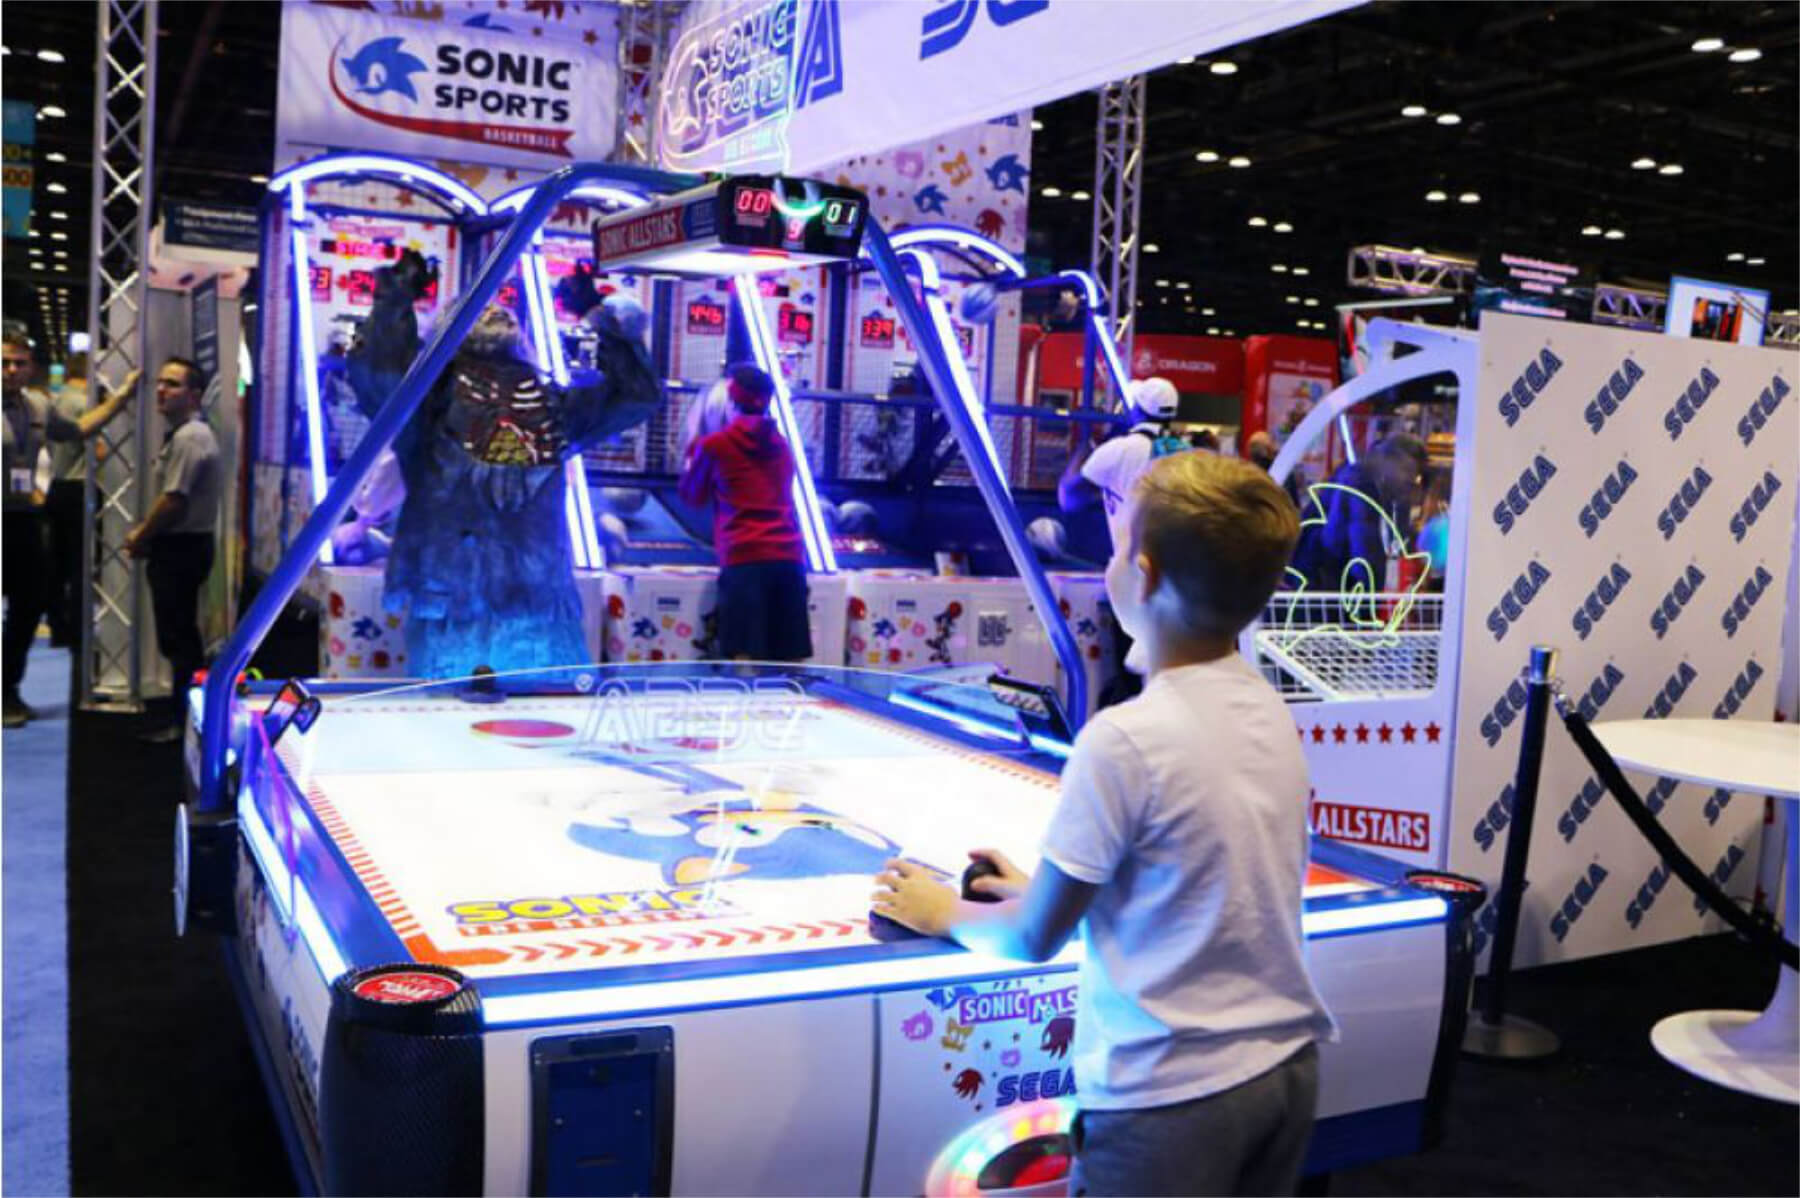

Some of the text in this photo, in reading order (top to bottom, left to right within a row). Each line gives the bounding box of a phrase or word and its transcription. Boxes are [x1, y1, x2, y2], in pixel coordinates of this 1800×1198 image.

[436, 43, 572, 91] SONIC
[434, 83, 570, 123] SPORTS
[483, 126, 558, 149] BASKETBALL
[629, 209, 678, 250] ALLSTARS
[737, 190, 768, 213] 00
[826, 203, 857, 224] 01
[1498, 347, 1564, 428] SEGA
[1583, 358, 1645, 435] SEGA
[1664, 367, 1721, 441] SEGA
[1737, 375, 1791, 447] SEGA
[1492, 454, 1558, 536] SEGA
[1578, 460, 1639, 539] SEGA
[1657, 466, 1713, 541] SEGA
[1729, 471, 1782, 544] SEGA
[1486, 560, 1551, 641] SEGA
[1572, 562, 1632, 640] SEGA
[1649, 564, 1706, 640] SEGA
[1721, 565, 1773, 639] SEGA
[1574, 664, 1625, 722] EGA
[1316, 804, 1427, 849] ALLSTARS
[1473, 783, 1516, 853] SEG
[1557, 776, 1606, 841] SEG
[445, 888, 706, 923] SONIC
[1551, 863, 1608, 943] SEGA
[963, 991, 1028, 1022] SONIC
[995, 1065, 1078, 1109] SEGA
